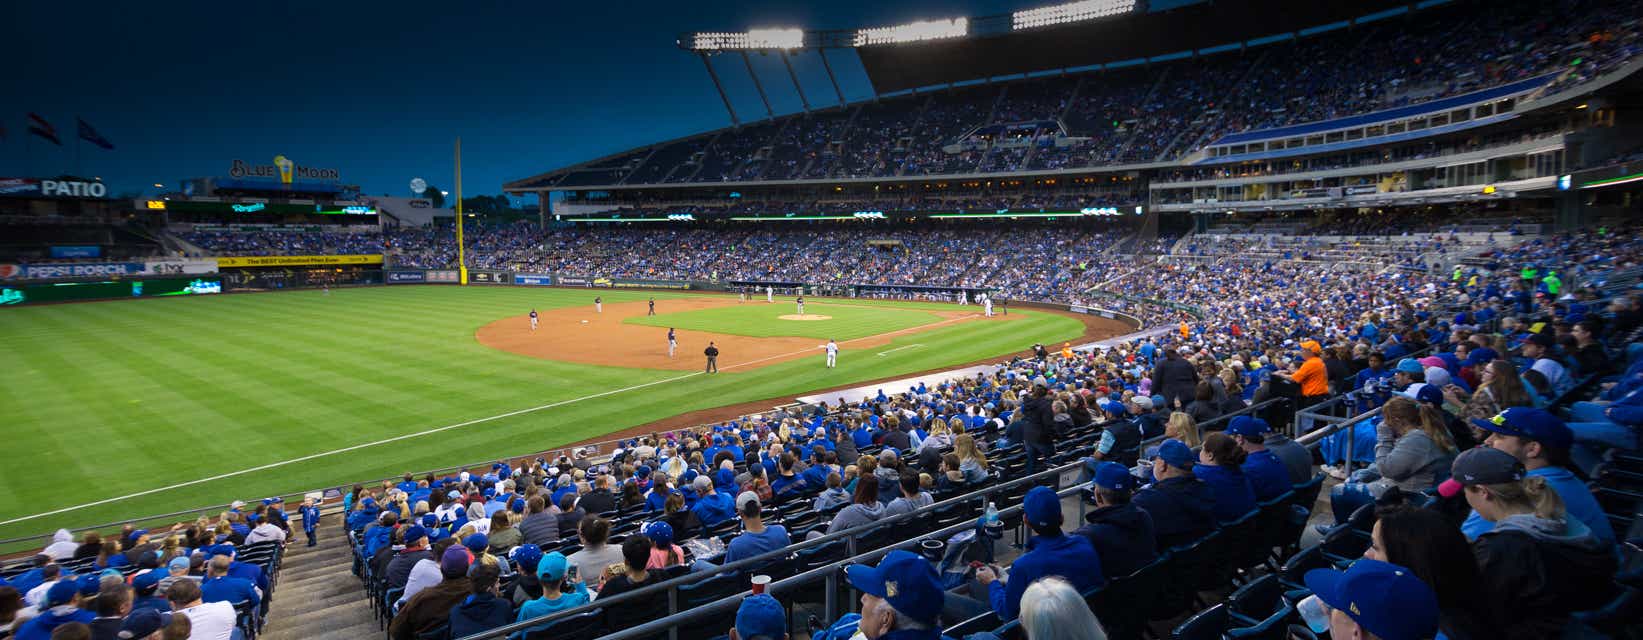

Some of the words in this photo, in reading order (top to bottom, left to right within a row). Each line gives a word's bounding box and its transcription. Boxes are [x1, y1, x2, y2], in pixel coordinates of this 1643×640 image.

[230, 159, 274, 178] BLUE
[297, 164, 338, 178] MOON
[41, 180, 106, 198] PATIO
[27, 265, 71, 279] PEPSI
[441, 513, 449, 522] 4
